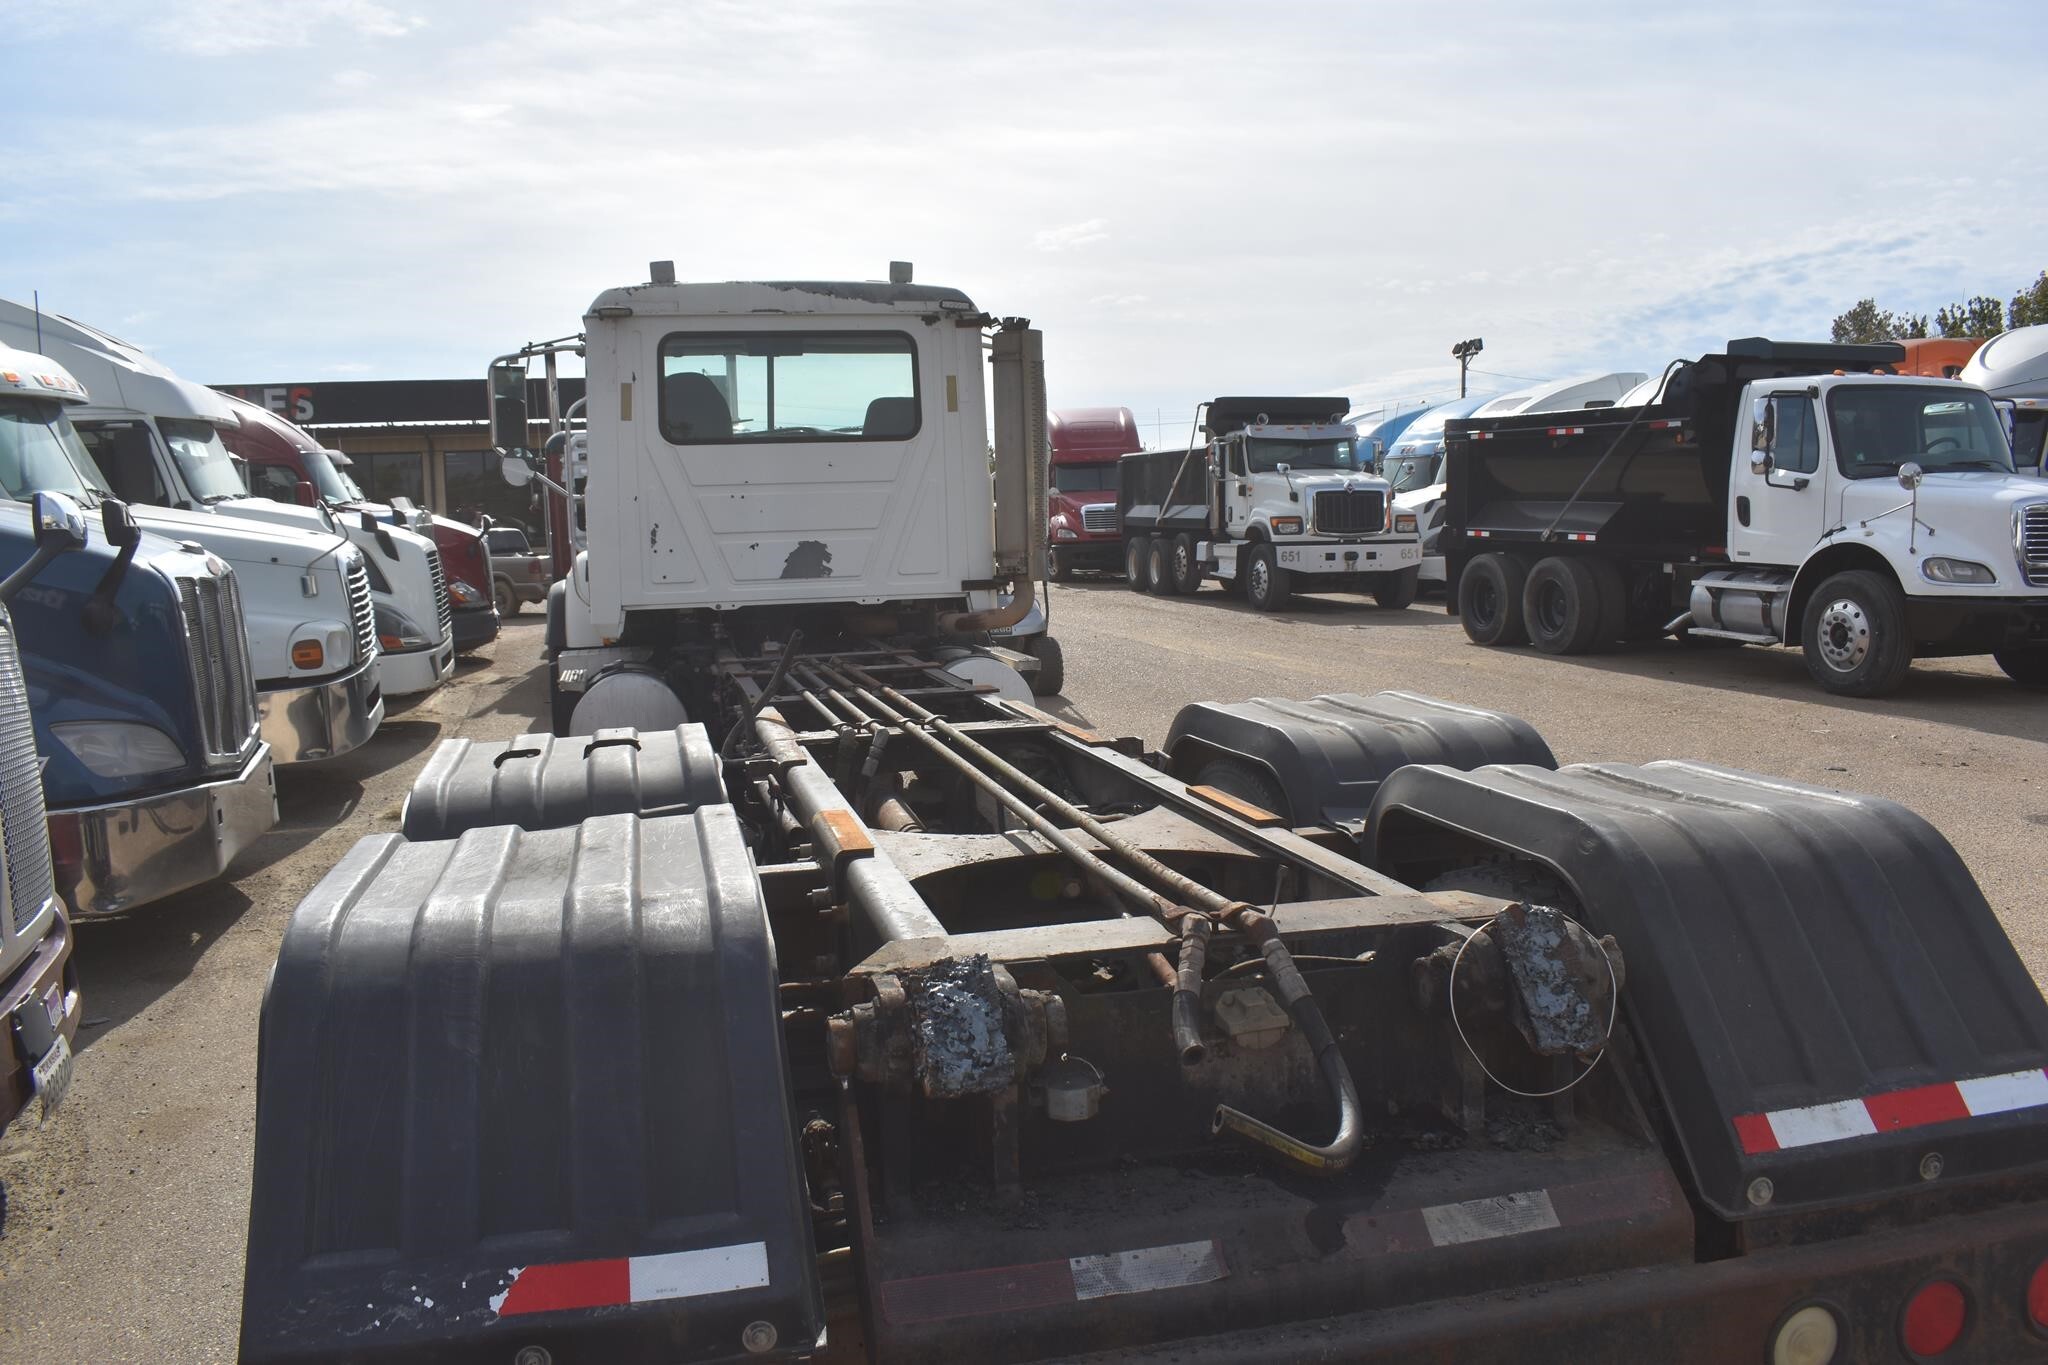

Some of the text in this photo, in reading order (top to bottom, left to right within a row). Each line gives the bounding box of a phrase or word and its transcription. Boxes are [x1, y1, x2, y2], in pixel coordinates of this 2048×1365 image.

[246, 386, 314, 420] ES
[1281, 551, 1300, 562] 651
[1400, 549, 1419, 560] 651
